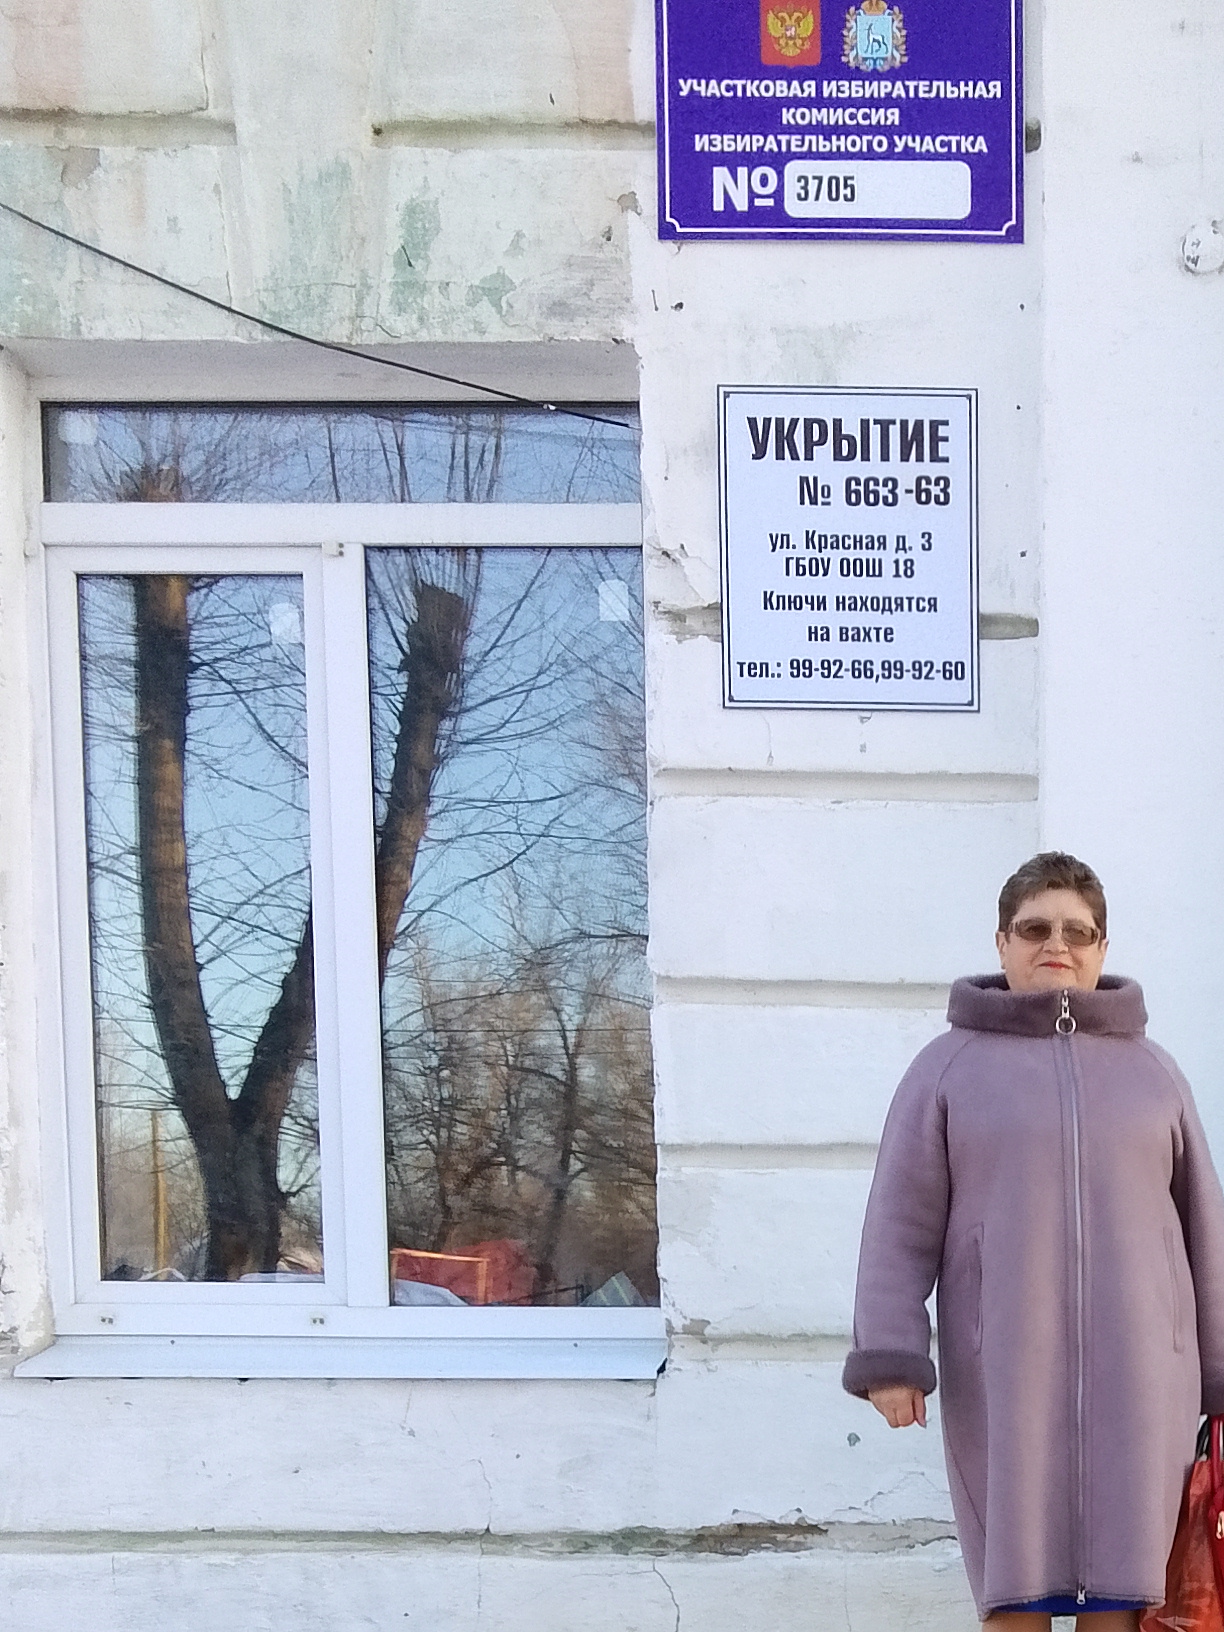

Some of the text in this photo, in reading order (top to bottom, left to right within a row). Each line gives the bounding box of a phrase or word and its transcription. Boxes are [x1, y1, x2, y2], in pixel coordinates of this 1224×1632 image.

[678, 78, 1002, 100] УЧАСТКОВАЯ ИЗБИРАТЕЛЬНАЯ
[781, 107, 900, 126] КОМИССИЯ
[694, 134, 988, 154] ИЗБИРАТЕЛЬНОГО УЧАСТКА
[712, 165, 856, 212] № 3705
[746, 416, 950, 463] УКРЫТИЕ
[799, 475, 832, 506] №
[769, 530, 933, 554] ул. Красная д. 3
[785, 557, 915, 579] ГБОУ ООШ 18
[763, 591, 938, 615] Ключи находятся
[808, 625, 895, 643] на вахте
[736, 660, 782, 680] тел.:
